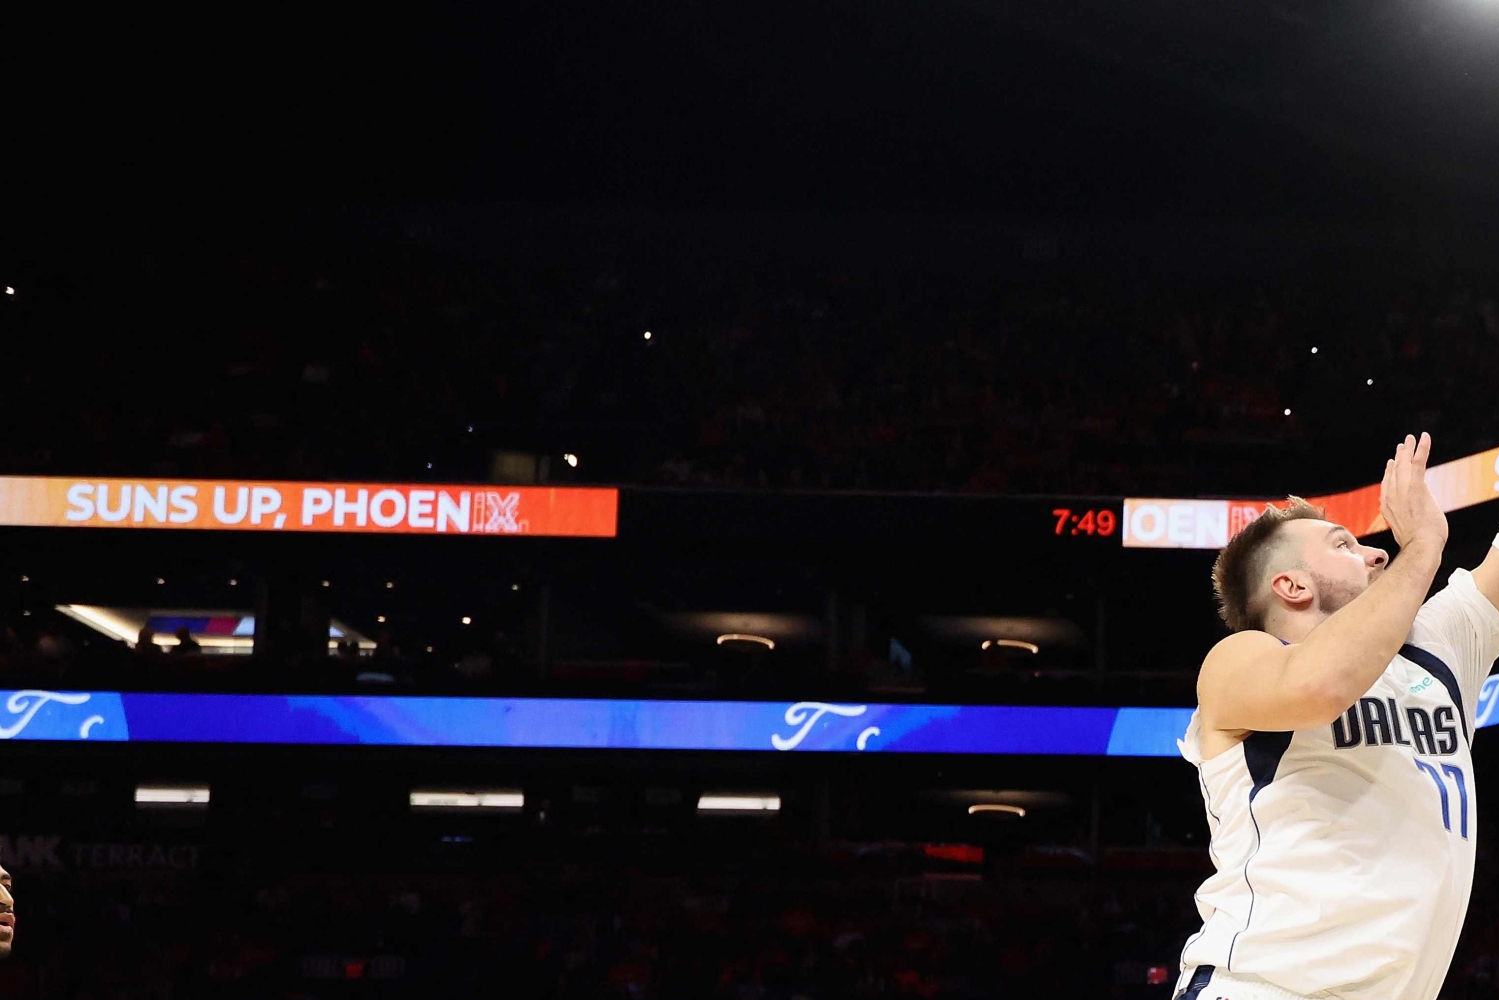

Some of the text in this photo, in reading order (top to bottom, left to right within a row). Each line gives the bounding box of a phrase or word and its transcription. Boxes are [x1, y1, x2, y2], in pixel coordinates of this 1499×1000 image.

[66, 483, 198, 523] SUNS
[213, 487, 288, 530] UP,
[1052, 508, 1117, 537] 7:49
[1413, 758, 1469, 842] 77
